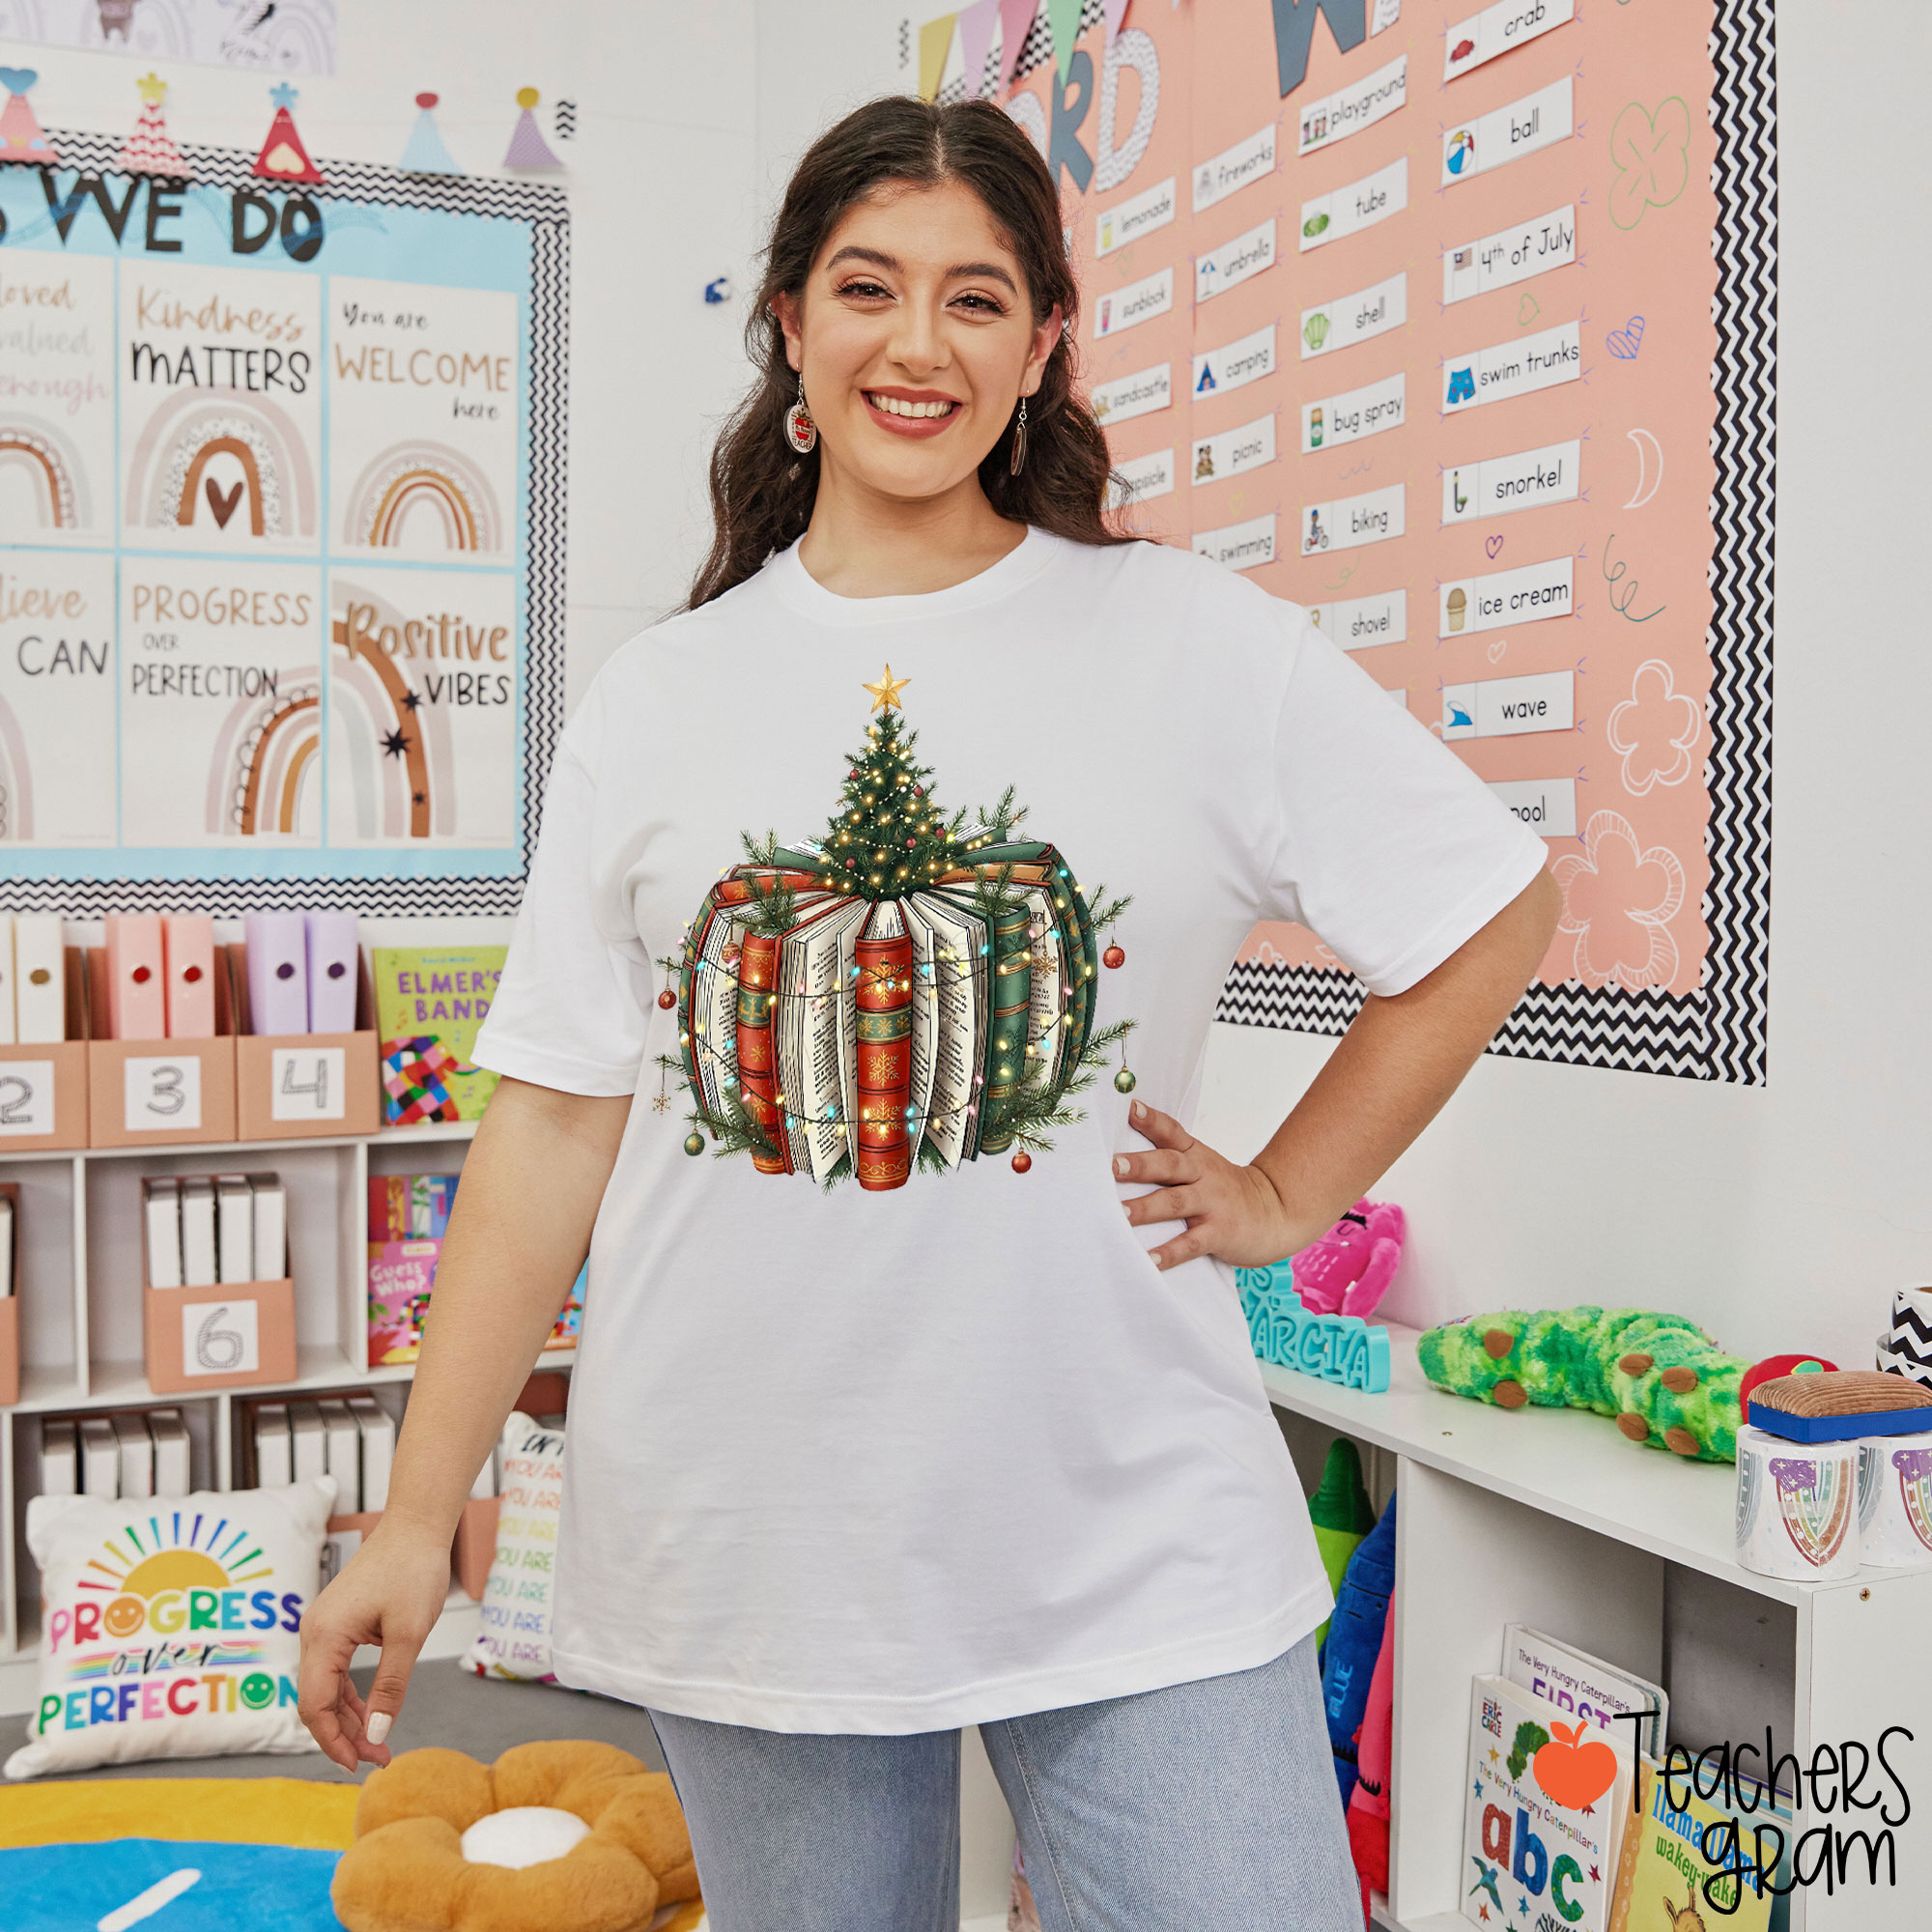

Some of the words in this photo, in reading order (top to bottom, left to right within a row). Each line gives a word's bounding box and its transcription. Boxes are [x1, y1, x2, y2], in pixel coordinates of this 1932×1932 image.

[1505, 0, 1546, 37] crab
[1331, 64, 1406, 131] playground
[1511, 106, 1540, 144] ball
[1218, 142, 1273, 187] fireworks
[40, 166, 185, 252] WE
[232, 188, 325, 263] DO
[1121, 193, 1172, 233] lemonade
[1355, 187, 1387, 217] tube
[1224, 238, 1270, 277] umbrella
[1481, 242, 1505, 273] 4th
[1511, 235, 1531, 266] of
[1538, 223, 1574, 255] July
[136, 285, 305, 342] Kindness
[1122, 281, 1167, 319] sunblock
[1355, 296, 1386, 329] shell
[335, 342, 511, 392] WELCOME
[1225, 349, 1269, 378] camping
[1479, 363, 1520, 386] swim
[1525, 340, 1580, 374] trunks
[452, 396, 500, 420] here
[1333, 410, 1360, 434] bug
[1364, 396, 1404, 427] spray
[1232, 440, 1264, 469] picnic
[1495, 458, 1562, 499] snorkel
[1351, 510, 1389, 533] biking
[1219, 535, 1272, 563] swimming
[132, 584, 312, 626] PROGRESS
[1478, 596, 1503, 616] ice
[1510, 583, 1569, 611] cream
[347, 602, 509, 662] Positive
[1350, 606, 1391, 637] shovel
[17, 636, 109, 676] CAN
[143, 633, 180, 652] OVER
[131, 663, 279, 696] PERFECTION
[424, 672, 511, 706] VIBES
[1501, 699, 1548, 720] wave
[414, 999, 492, 1023] BAND
[146, 1065, 185, 1116] 3
[280, 1058, 328, 1109] 4
[369, 1261, 422, 1282] Guess
[374, 1274, 428, 1297] Who?
[196, 1305, 244, 1370] 6
[1246, 1304, 1370, 1388] ARCIA
[50, 1591, 304, 1654] PROGRESS
[111, 1641, 230, 1676] over
[1328, 1660, 1353, 1719] BLUE
[1519, 1648, 1532, 1665] The
[1532, 1656, 1550, 1677] Very
[1550, 1664, 1580, 1692] Hungry
[1580, 1680, 1631, 1714] Caterpillar's
[38, 1672, 299, 1735] PERFECTION
[1479, 1760, 1492, 1779] The
[1493, 1772, 1513, 1798] Very
[1513, 1785, 1543, 1820] Hungry
[1544, 1808, 1599, 1855] Caterpillar's
[1482, 1803, 1585, 1923] abc
